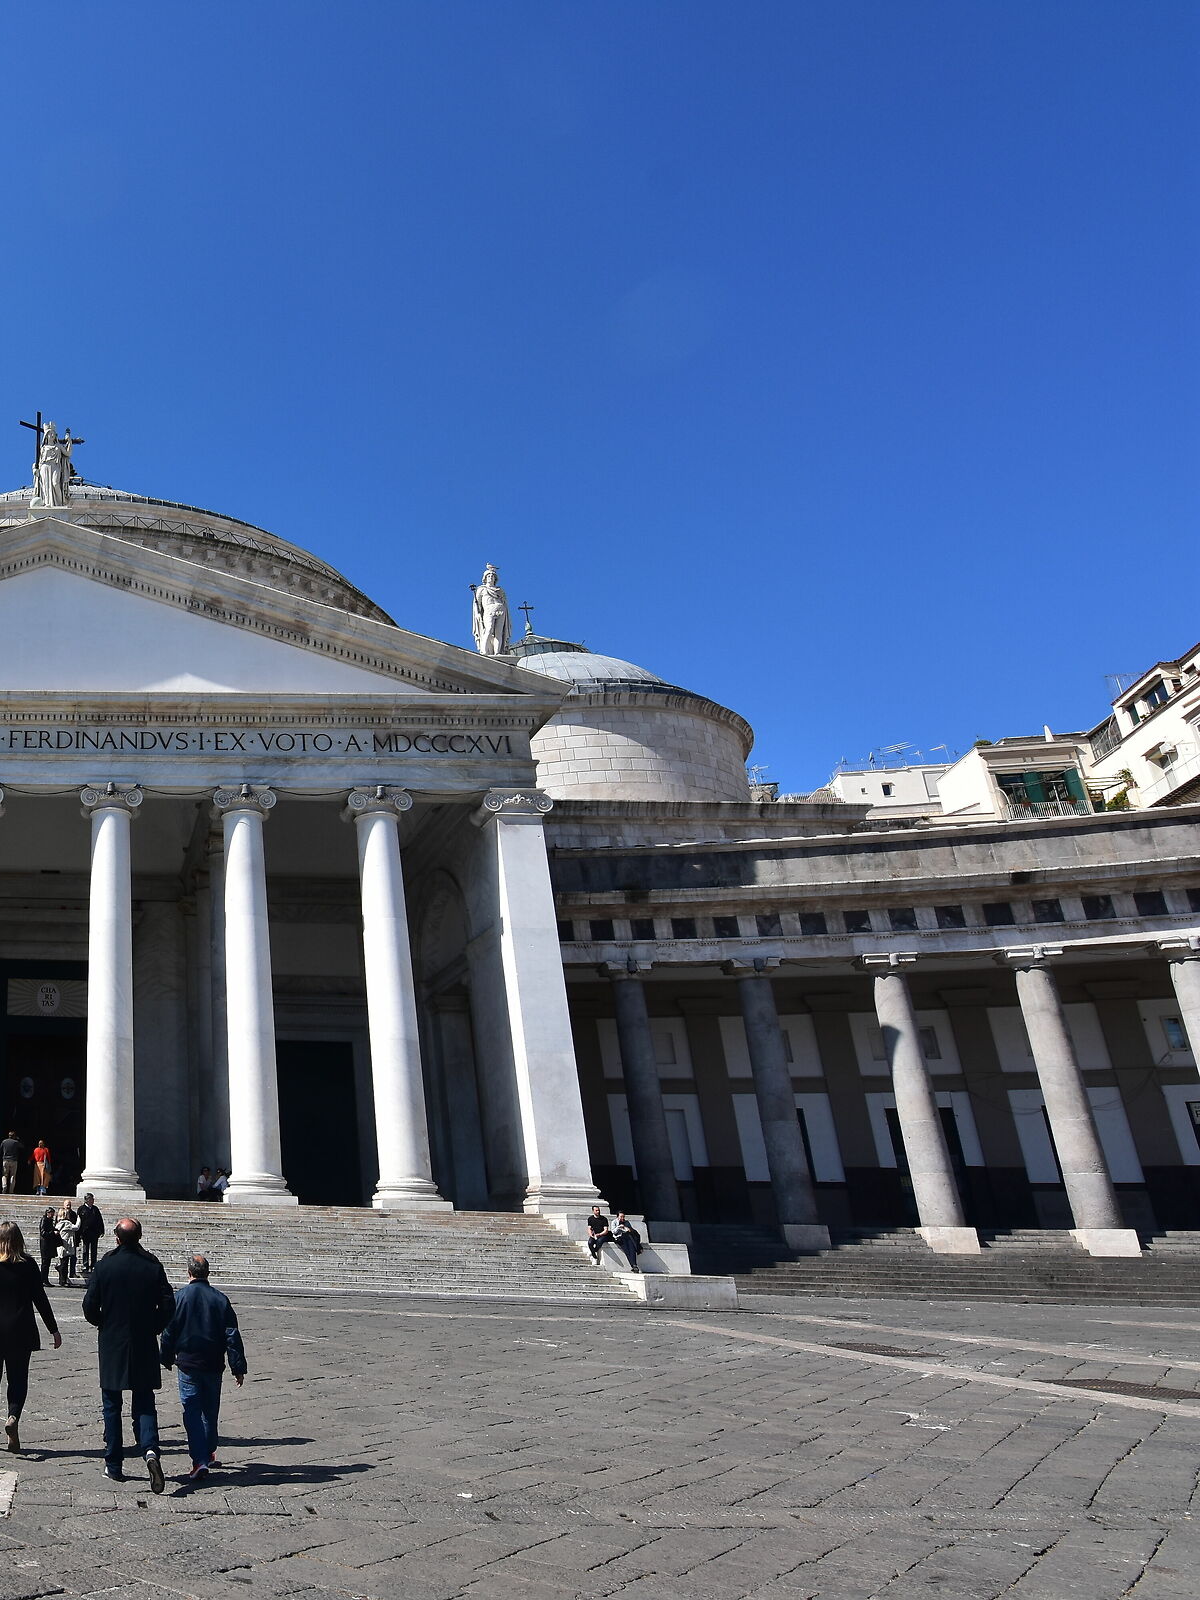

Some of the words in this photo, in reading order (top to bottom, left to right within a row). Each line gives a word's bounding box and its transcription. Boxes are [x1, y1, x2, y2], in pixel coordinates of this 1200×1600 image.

[8, 730, 189, 751] FERDINANDVS
[214, 732, 246, 751] EX
[257, 732, 333, 752] VOTO
[345, 733, 363, 752] A
[372, 733, 513, 753] MDCCCXVI
